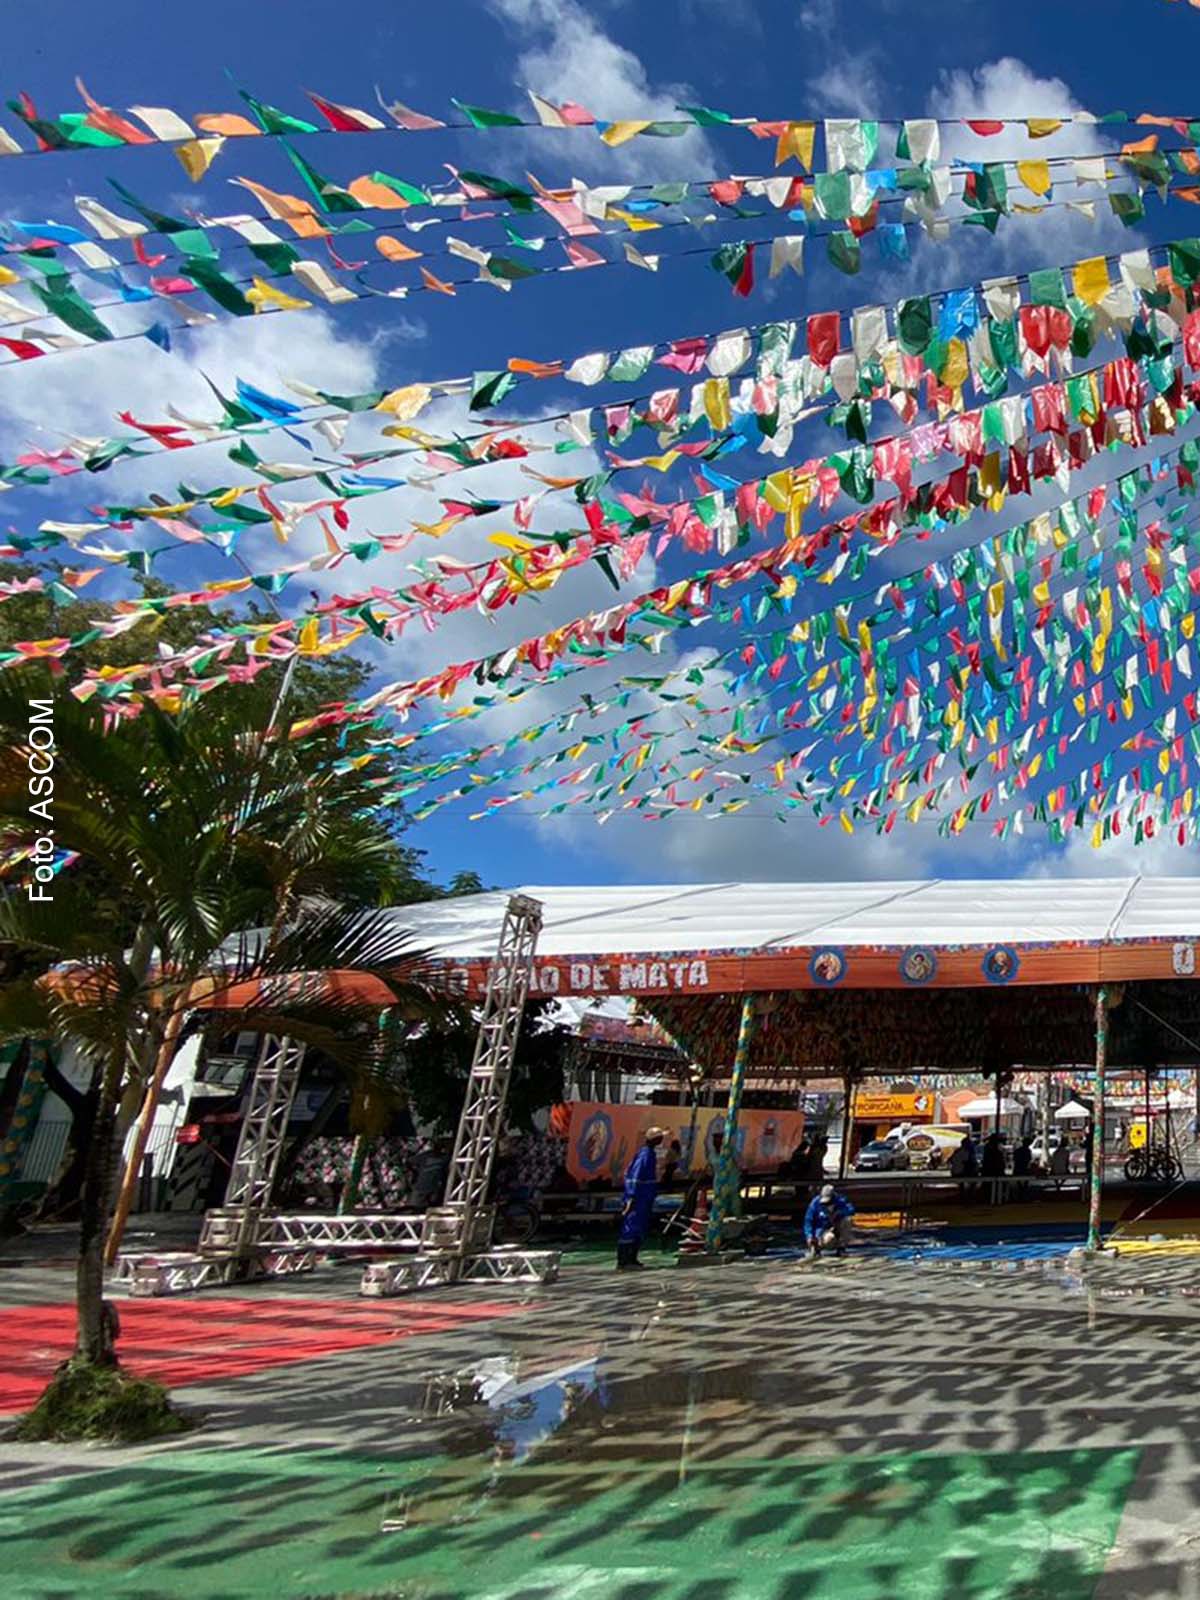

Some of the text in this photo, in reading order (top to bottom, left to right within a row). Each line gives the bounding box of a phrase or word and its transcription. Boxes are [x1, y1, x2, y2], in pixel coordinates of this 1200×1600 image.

[1172, 942, 1196, 975] O
[570, 963, 609, 990] DE
[619, 960, 708, 991] MATA
